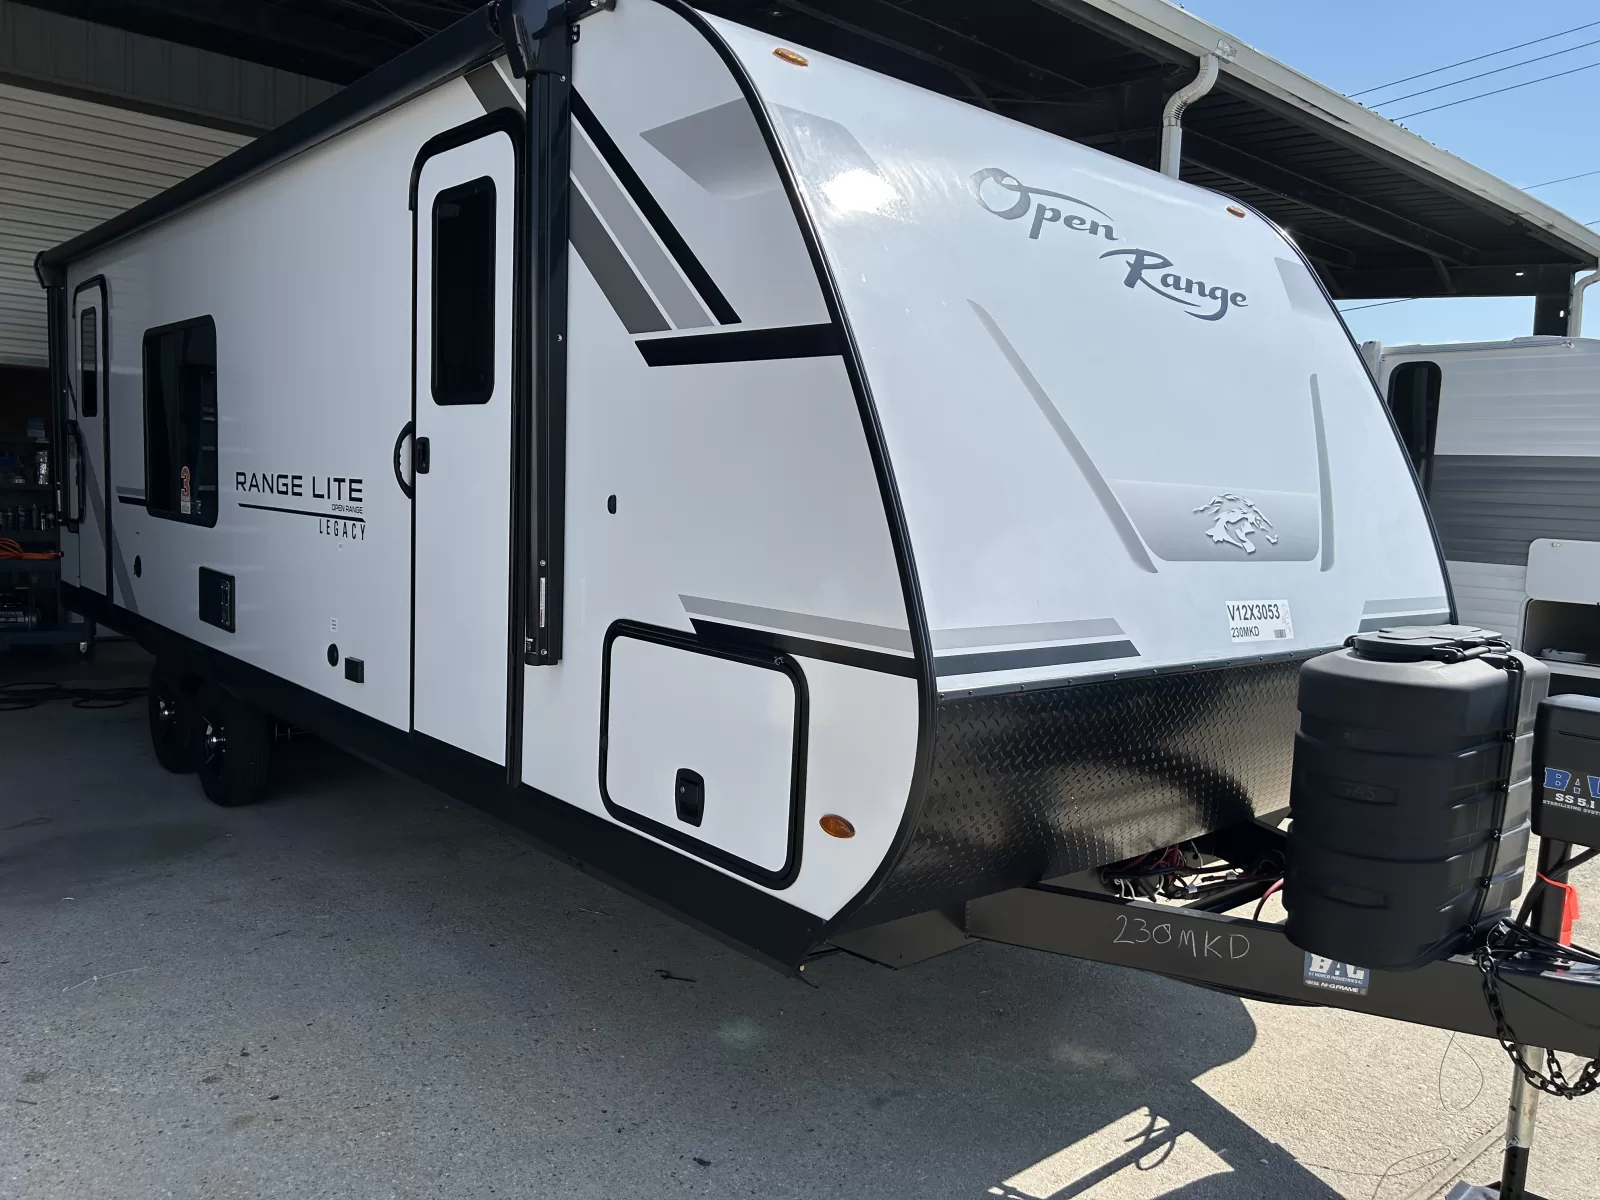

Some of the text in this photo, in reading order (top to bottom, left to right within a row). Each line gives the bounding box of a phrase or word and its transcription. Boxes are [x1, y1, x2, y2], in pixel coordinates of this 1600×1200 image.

[966, 167, 1119, 240] Open
[1099, 248, 1249, 321] Range
[236, 472, 363, 502] RANGE LITE
[332, 504, 363, 514] OPEN RANGE
[319, 518, 366, 540] LEGACY
[1227, 604, 1280, 621] V12X3053
[1231, 626, 1260, 638] 230MKD
[1542, 799, 1600, 816] STABILIZING SYST
[1555, 793, 1595, 809] SS 5.1
[1113, 914, 1250, 960] 230MKD
